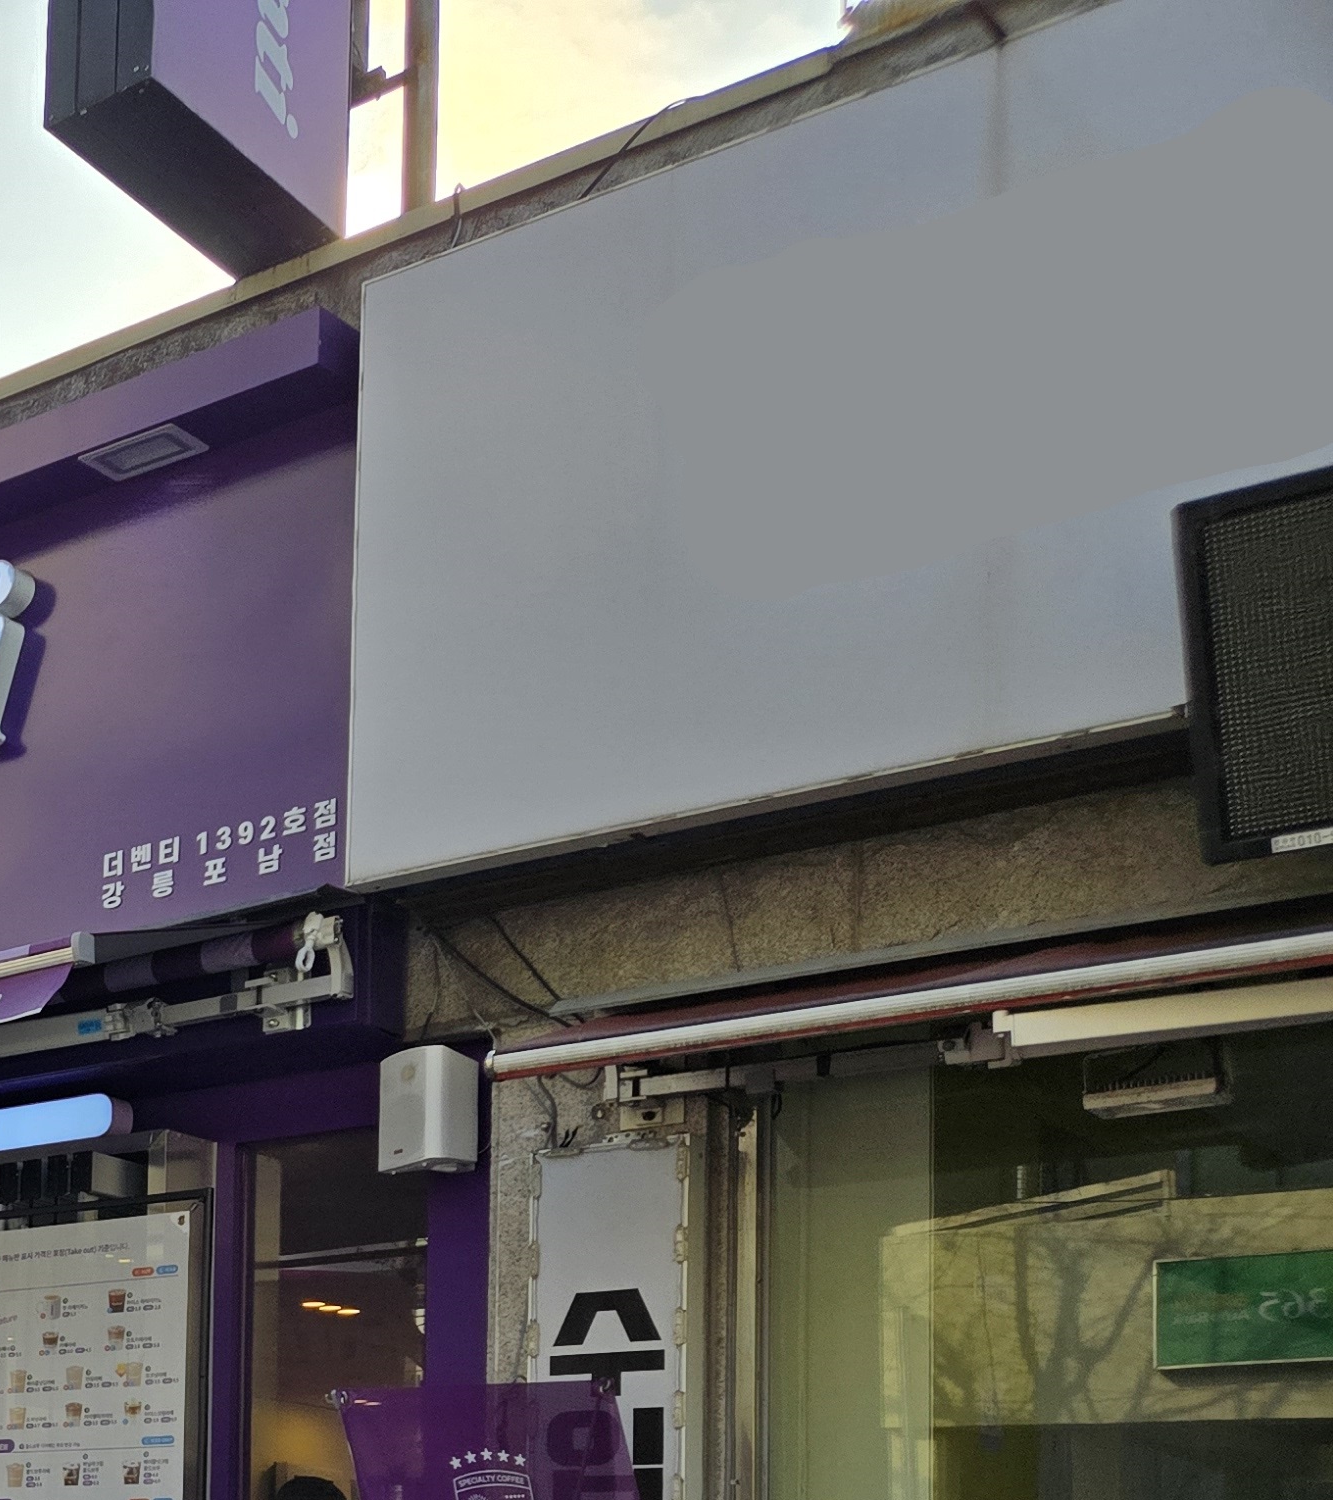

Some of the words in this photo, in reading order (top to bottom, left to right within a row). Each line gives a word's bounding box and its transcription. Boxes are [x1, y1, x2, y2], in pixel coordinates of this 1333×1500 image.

[102, 836, 181, 879] 더벤티
[195, 797, 337, 855] 1392호점
[458, 1474, 496, 1487] SPECIALTY
[496, 1474, 524, 1484] COFFEE
